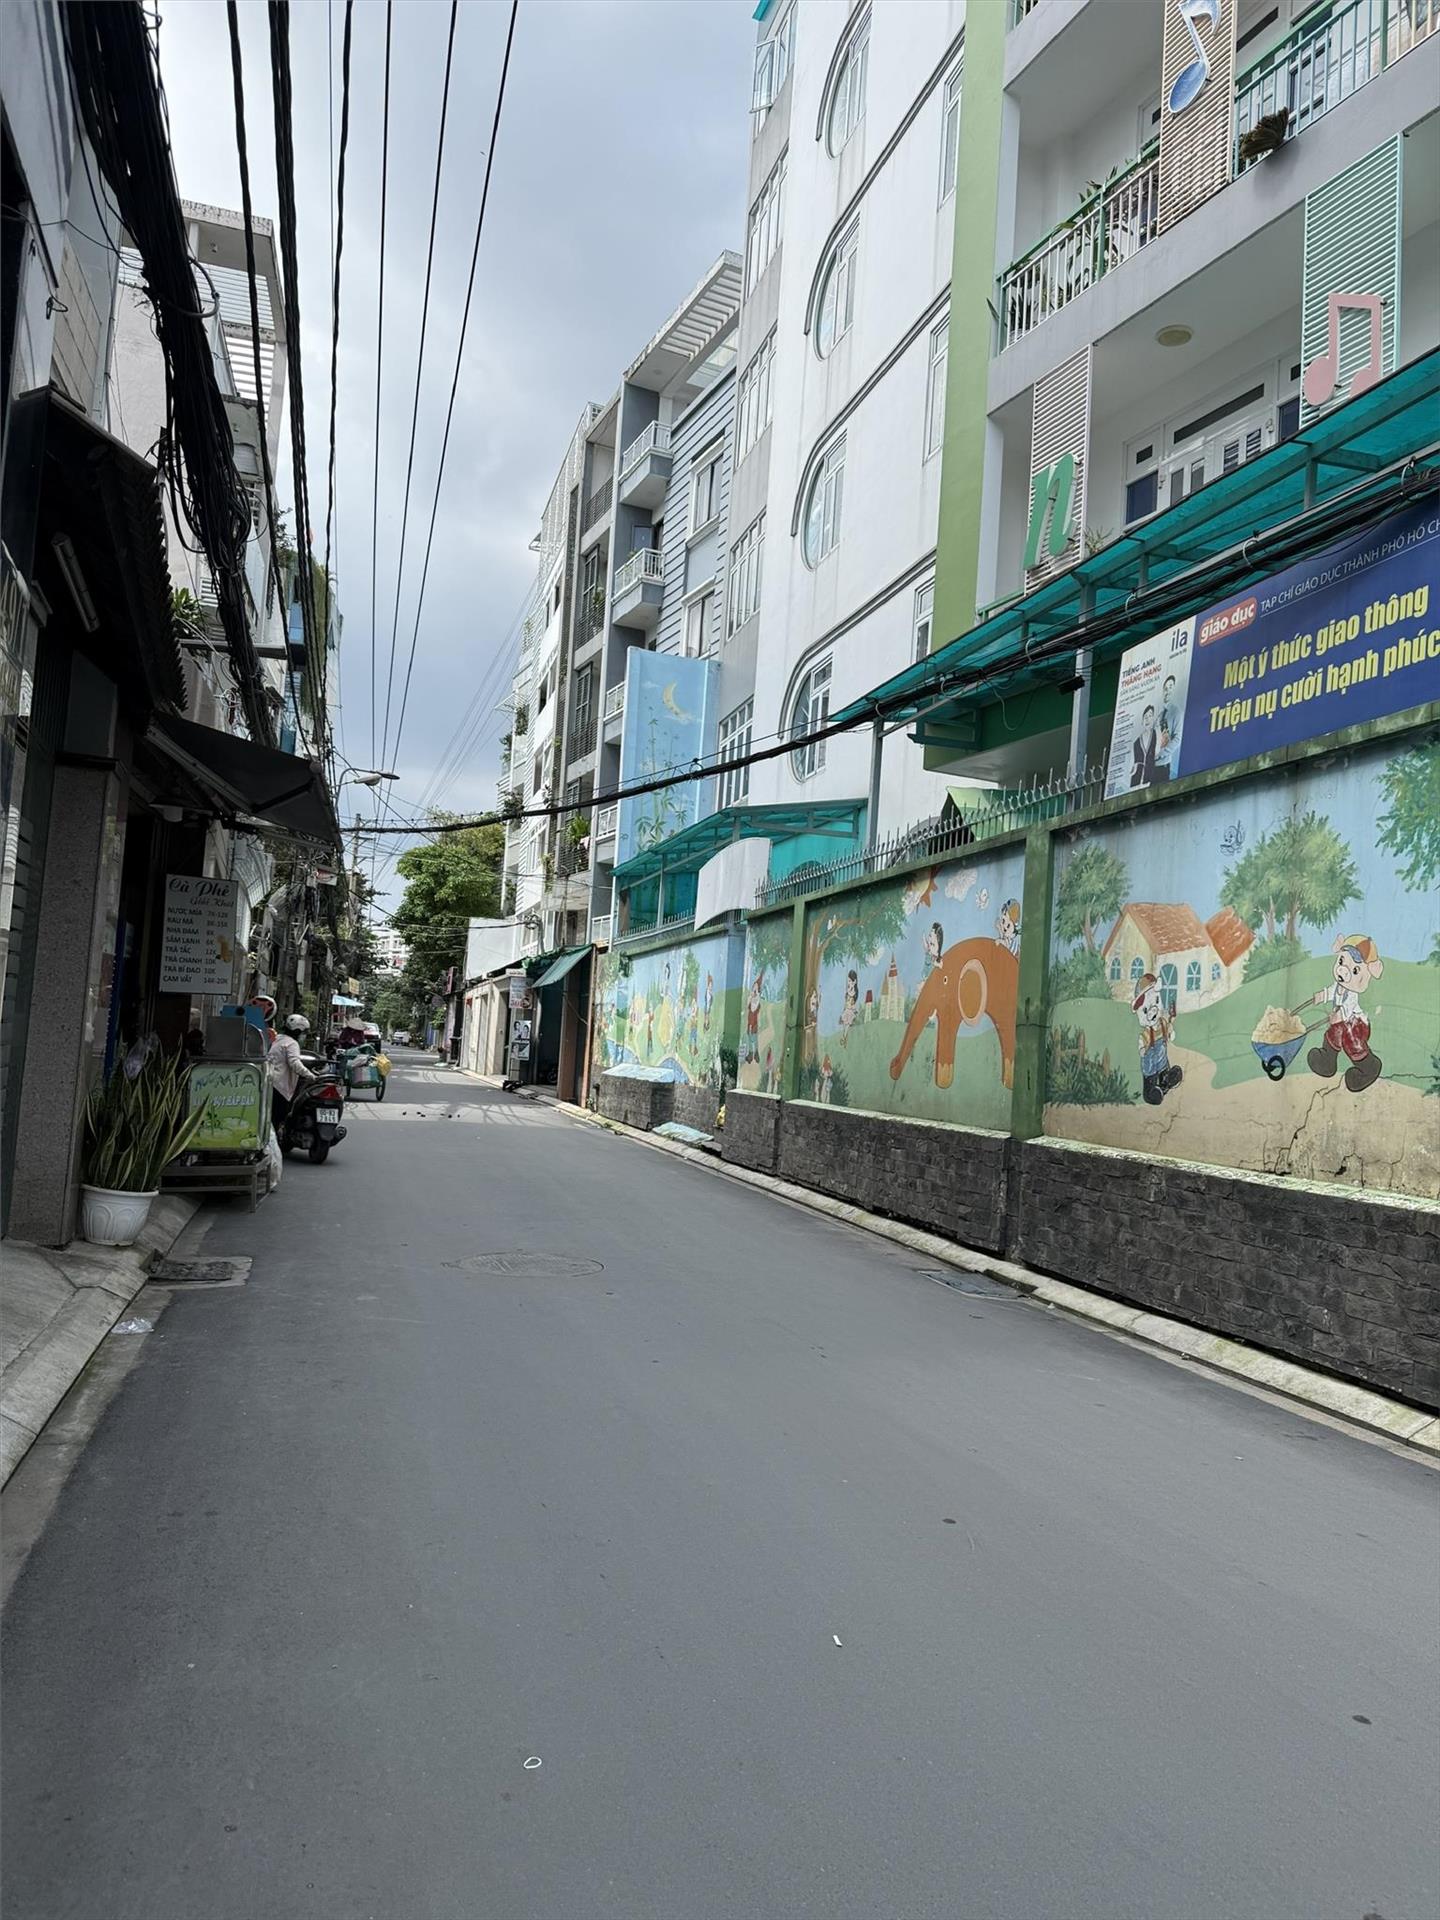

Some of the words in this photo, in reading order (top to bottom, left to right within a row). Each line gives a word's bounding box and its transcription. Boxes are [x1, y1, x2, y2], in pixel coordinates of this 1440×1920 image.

[1261, 596, 1277, 612] TẠP
[1278, 585, 1294, 603] CHÍ
[1295, 577, 1319, 596] GIÁO
[1320, 565, 1342, 584] DỤC
[1342, 550, 1380, 574] THÀNH
[1170, 629, 1188, 652] ila
[1200, 615, 1228, 643] giáo
[1230, 603, 1255, 628] dục
[1223, 655, 1255, 690] Một
[1257, 647, 1269, 678] ý
[1271, 633, 1312, 670] thức
[1315, 614, 1360, 655] giao
[1364, 584, 1430, 634] thông
[1141, 657, 1156, 671] ANH
[1208, 699, 1251, 734] Triệu
[1254, 688, 1277, 720] nụ
[1280, 667, 1323, 708] cười
[1326, 649, 1379, 695] hạnh
[1383, 628, 1440, 677] phúc
[169, 878, 190, 893] Cà
[195, 880, 230, 897] Phê
